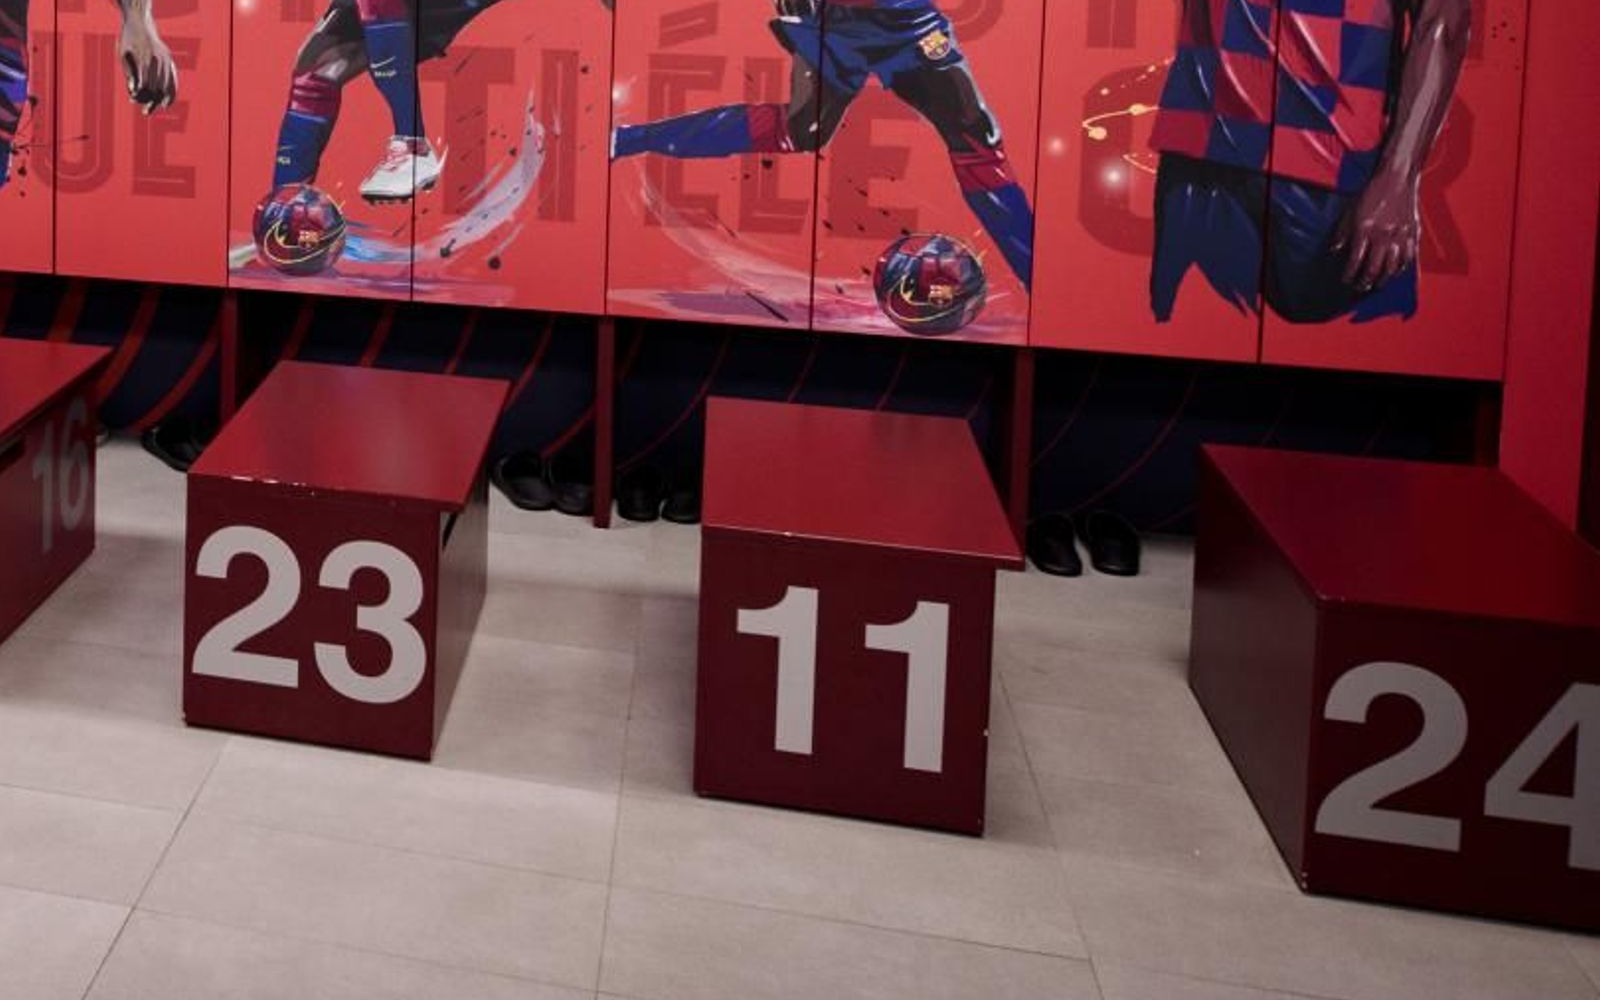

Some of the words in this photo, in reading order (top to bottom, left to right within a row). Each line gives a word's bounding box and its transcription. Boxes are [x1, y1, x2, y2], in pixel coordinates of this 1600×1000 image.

[31, 401, 90, 555] 16
[191, 525, 428, 704] 23
[736, 586, 951, 774] 11
[1313, 660, 1600, 872] 24
